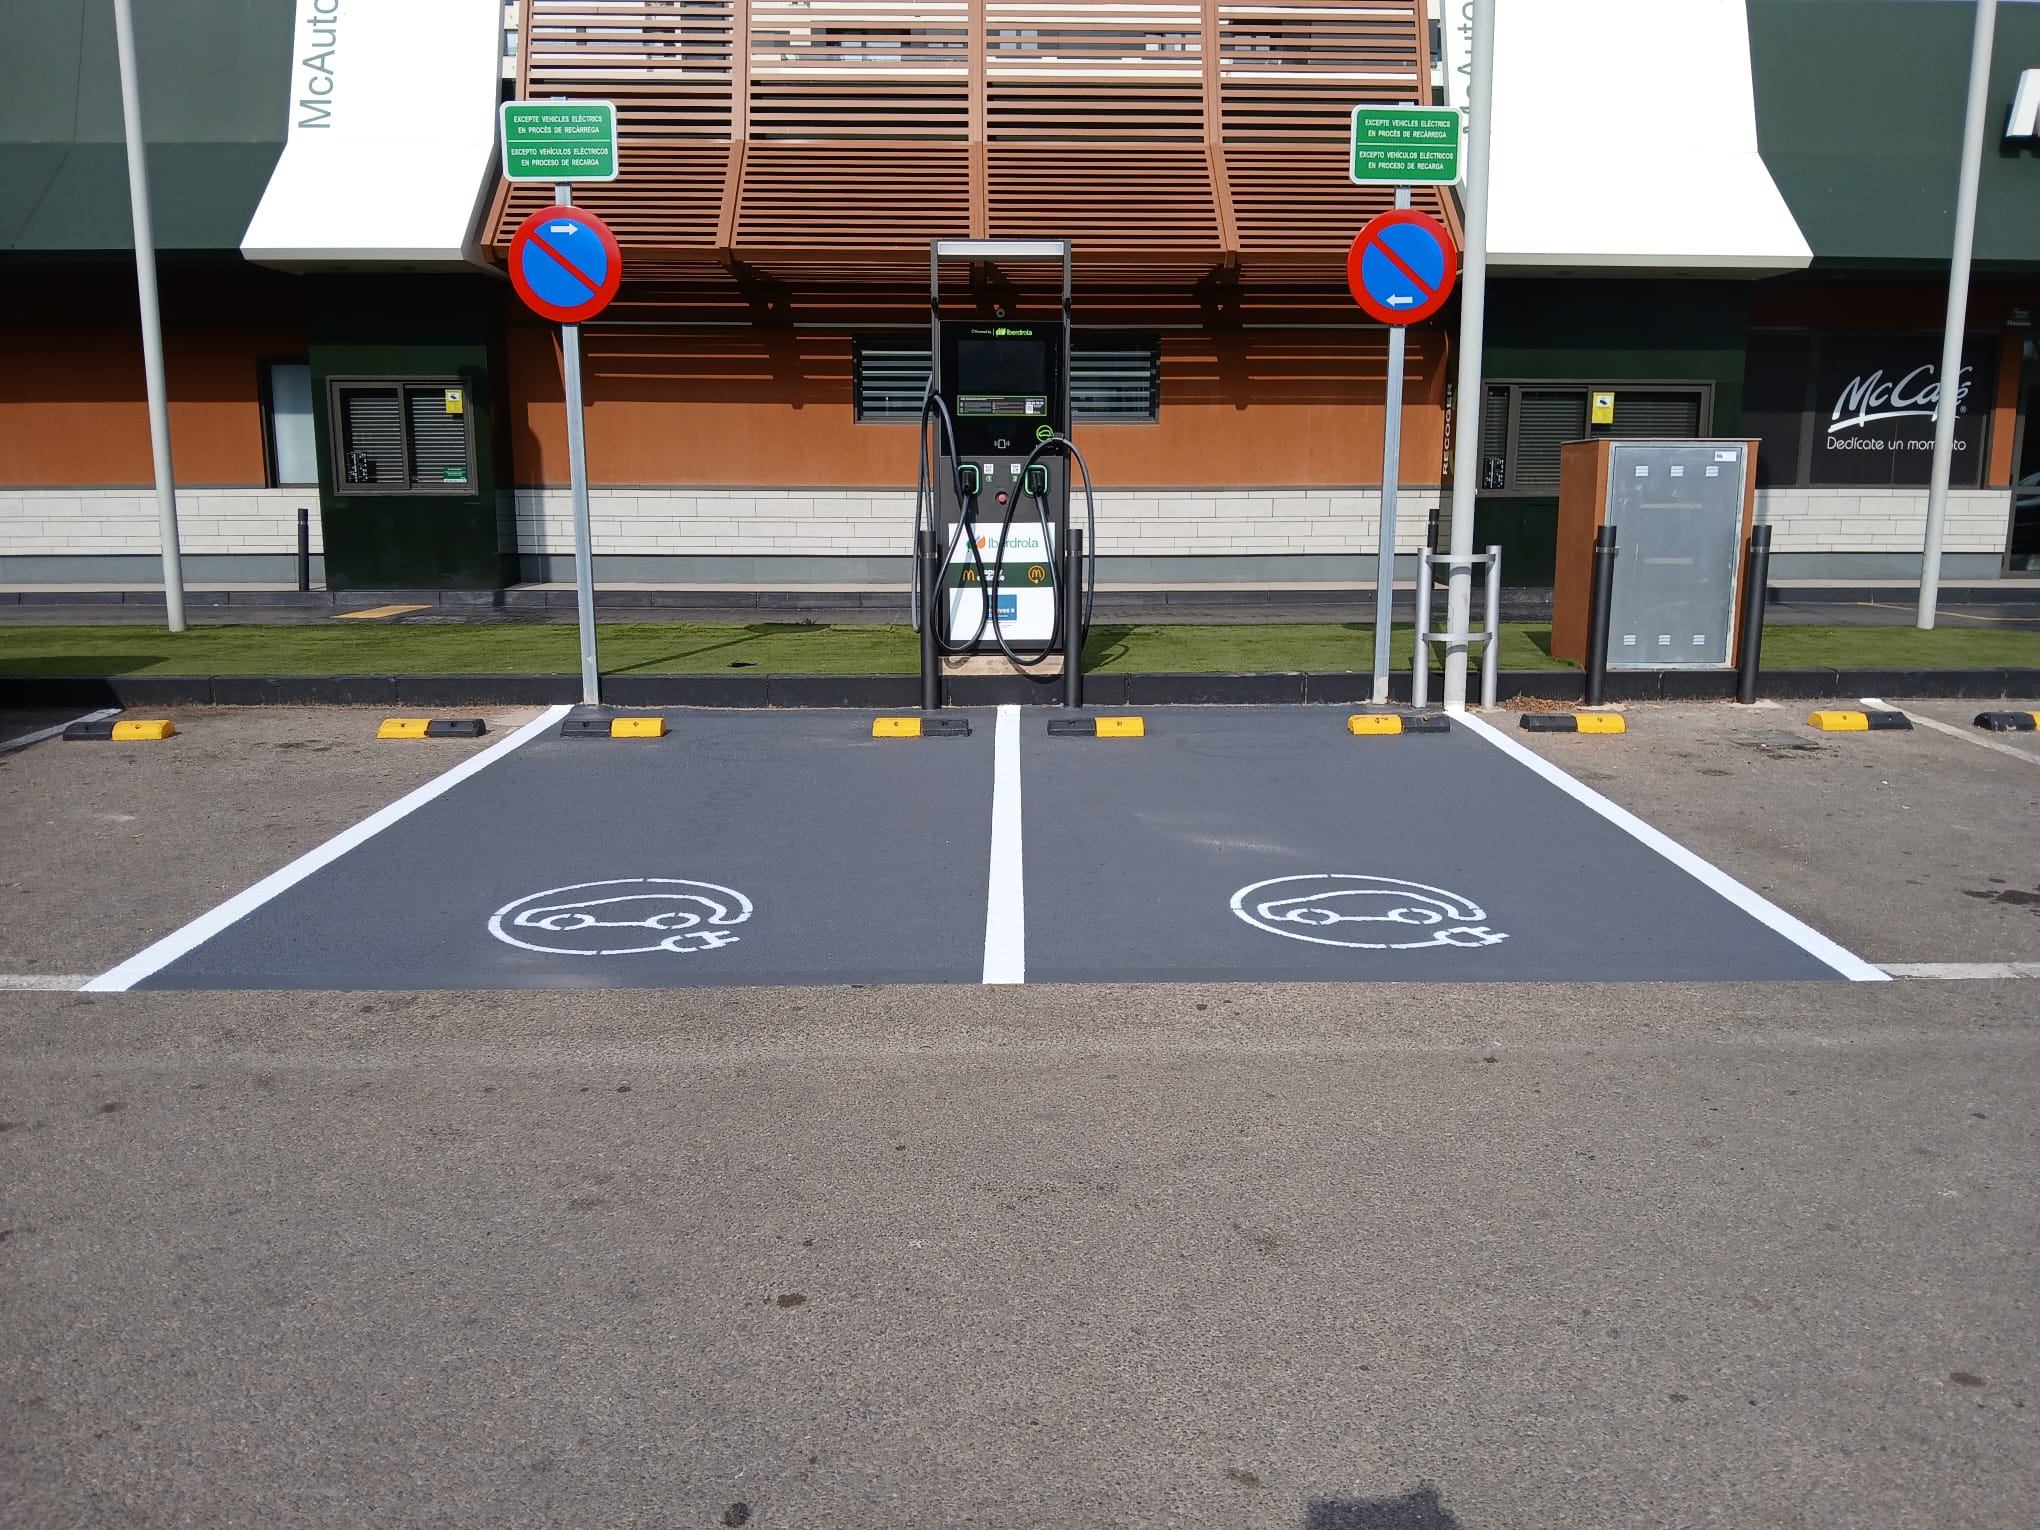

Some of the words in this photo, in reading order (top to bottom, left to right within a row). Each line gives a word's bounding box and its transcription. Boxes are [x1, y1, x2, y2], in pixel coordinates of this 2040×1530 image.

[298, 0, 338, 128] McAuto
[514, 115, 539, 123] EXCEPTE
[1365, 119, 1390, 127] EXCEPTE
[518, 126, 526, 134] EN
[554, 126, 562, 134] DE
[1368, 129, 1376, 137] EN
[1403, 130, 1411, 138] DE
[511, 148, 537, 156] EXCEPTO
[540, 146, 571, 156] VEHÍCULOS
[1360, 150, 1385, 158] EXCEPTO
[1387, 149, 1418, 159] VEHÍCULOS
[1420, 151, 1454, 160] ELÉCTRICOS
[521, 159, 529, 167] EN
[532, 159, 559, 167] PROCESO
[562, 159, 570, 167] DE
[572, 158, 600, 167] RECARGA
[1368, 162, 1376, 170] EN
[1379, 162, 1405, 170] PROCESO
[1407, 162, 1415, 170] DE
[1417, 162, 1444, 170] RECARGA
[1006, 328, 1033, 336] Iberdrola
[1830, 364, 1974, 430] McCaé
[1442, 384, 1453, 475] RECOGER
[1827, 436, 1885, 451] Dedícate
[1888, 440, 1904, 451] un
[1907, 439, 1967, 451] momto
[988, 537, 1039, 549] Ibrdrola
